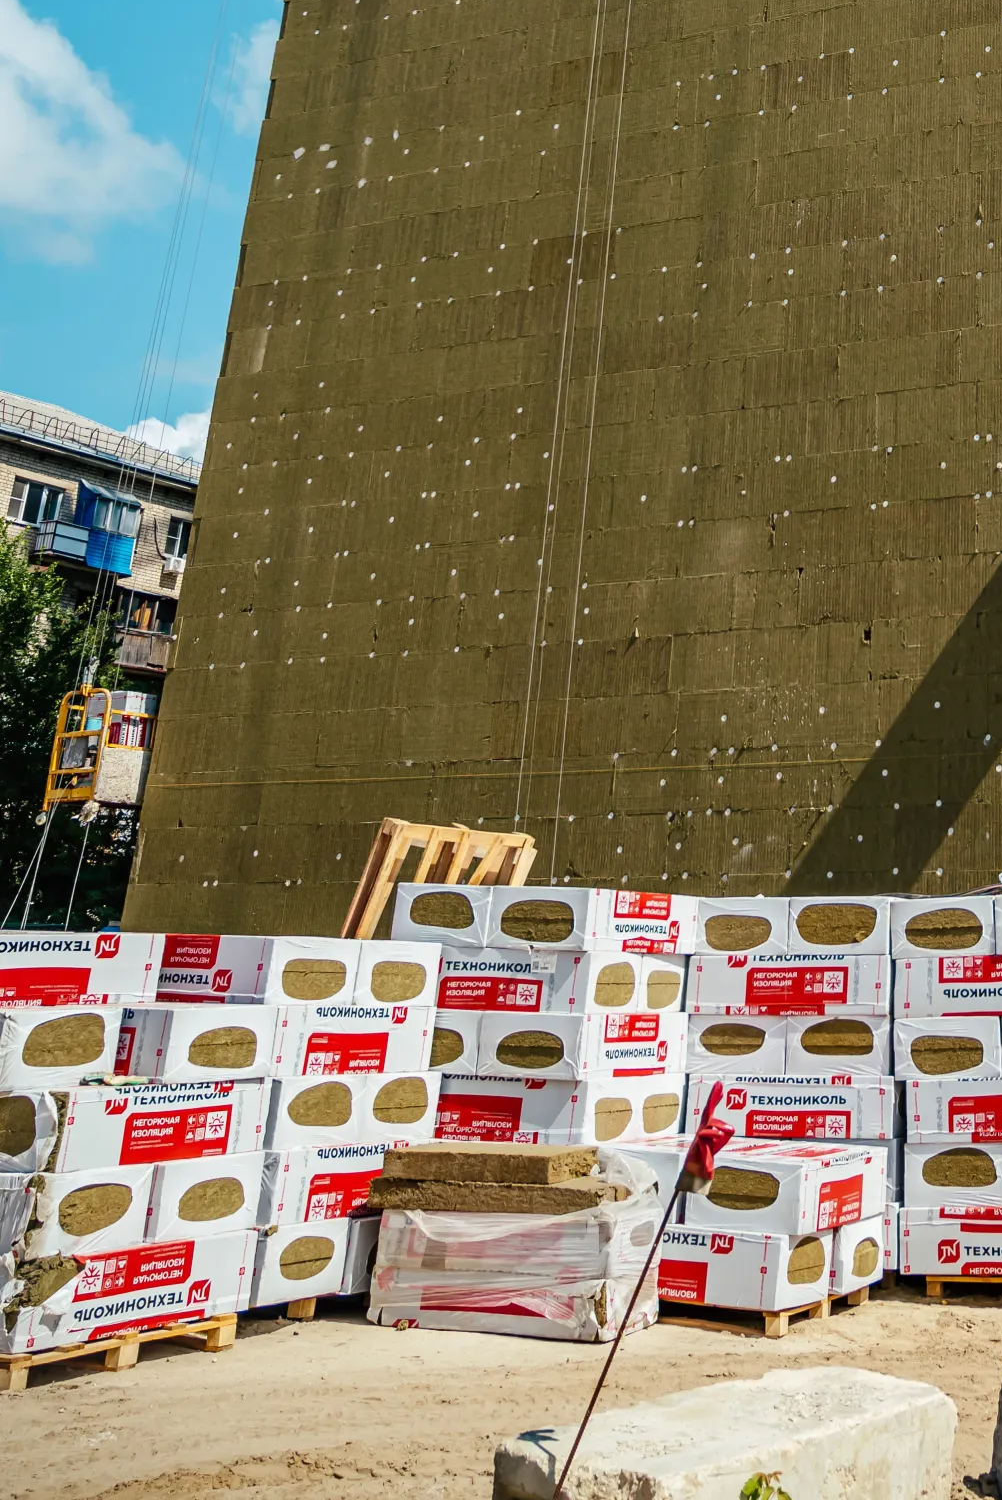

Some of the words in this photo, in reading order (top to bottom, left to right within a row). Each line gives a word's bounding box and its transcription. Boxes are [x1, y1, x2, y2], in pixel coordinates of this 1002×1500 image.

[614, 924, 667, 934] ТЕХНОНИКОЛЬ
[445, 961, 532, 974] ТЕХНОНИКОЛ
[316, 1006, 390, 1019] ТЕХНОНИКОЛЬ
[605, 1047, 655, 1060] ТЕХНОНИКОЛЬ
[750, 1095, 847, 1105] ТЕХНОНИКОЛЬ
[132, 1115, 180, 1127] НЕГОРЮЧАЯ
[472, 1120, 512, 1129] ИЗОЛЯЦИЯ
[752, 1123, 793, 1131] ИЗОЛЯЦИЯ
[131, 1127, 174, 1138] ИЗОЛЯЦИЯ
[140, 1257, 186, 1272] ИЗОЛЯЦИЯ
[132, 1268, 183, 1285] НЕГОРЮЧАЯ
[657, 1286, 697, 1299] ИЗОЛЯЦИ
[73, 1291, 184, 1323] ТЕХНОНИКОЛЬ
